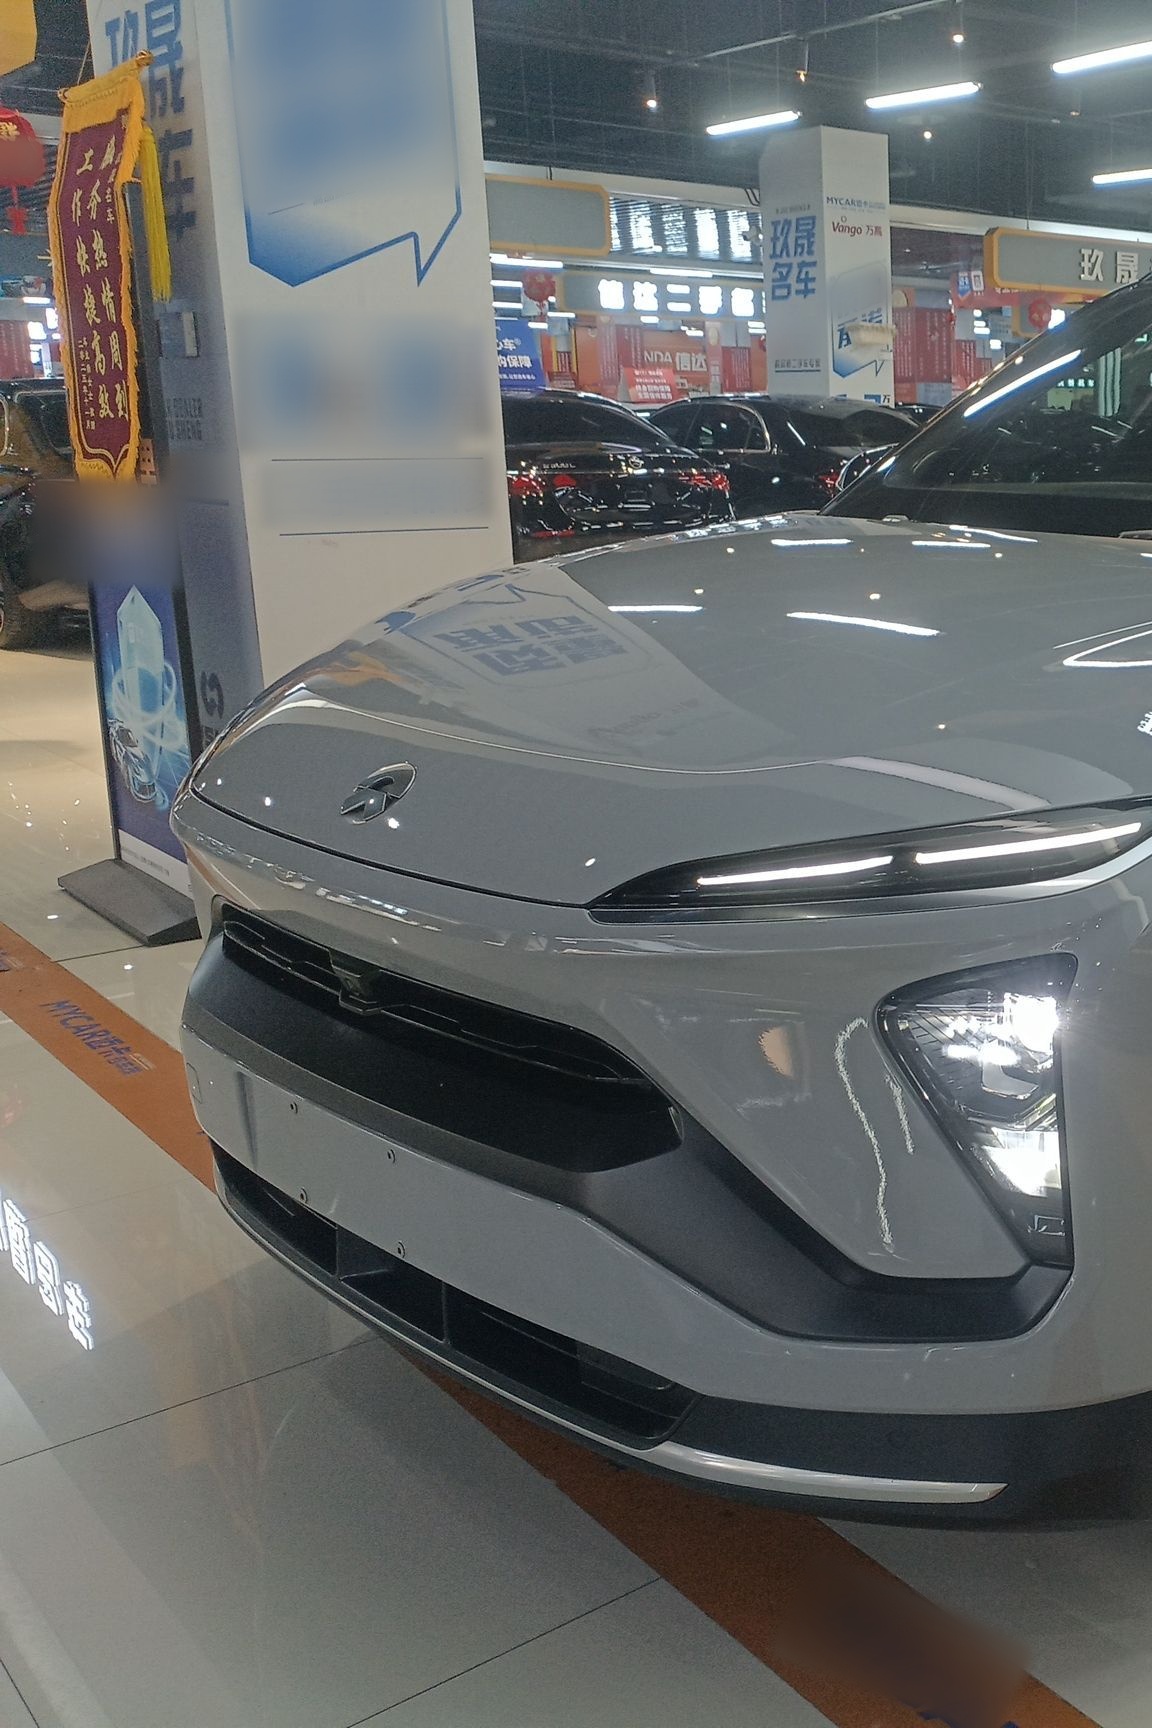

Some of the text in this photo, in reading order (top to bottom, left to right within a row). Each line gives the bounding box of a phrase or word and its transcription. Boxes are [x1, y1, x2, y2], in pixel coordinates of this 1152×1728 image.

[770, 216, 816, 260] 玖晟
[832, 222, 862, 237] Vango
[771, 260, 818, 300] 名车
[643, 350, 673, 364] NDA
[675, 352, 708, 372] 信达
